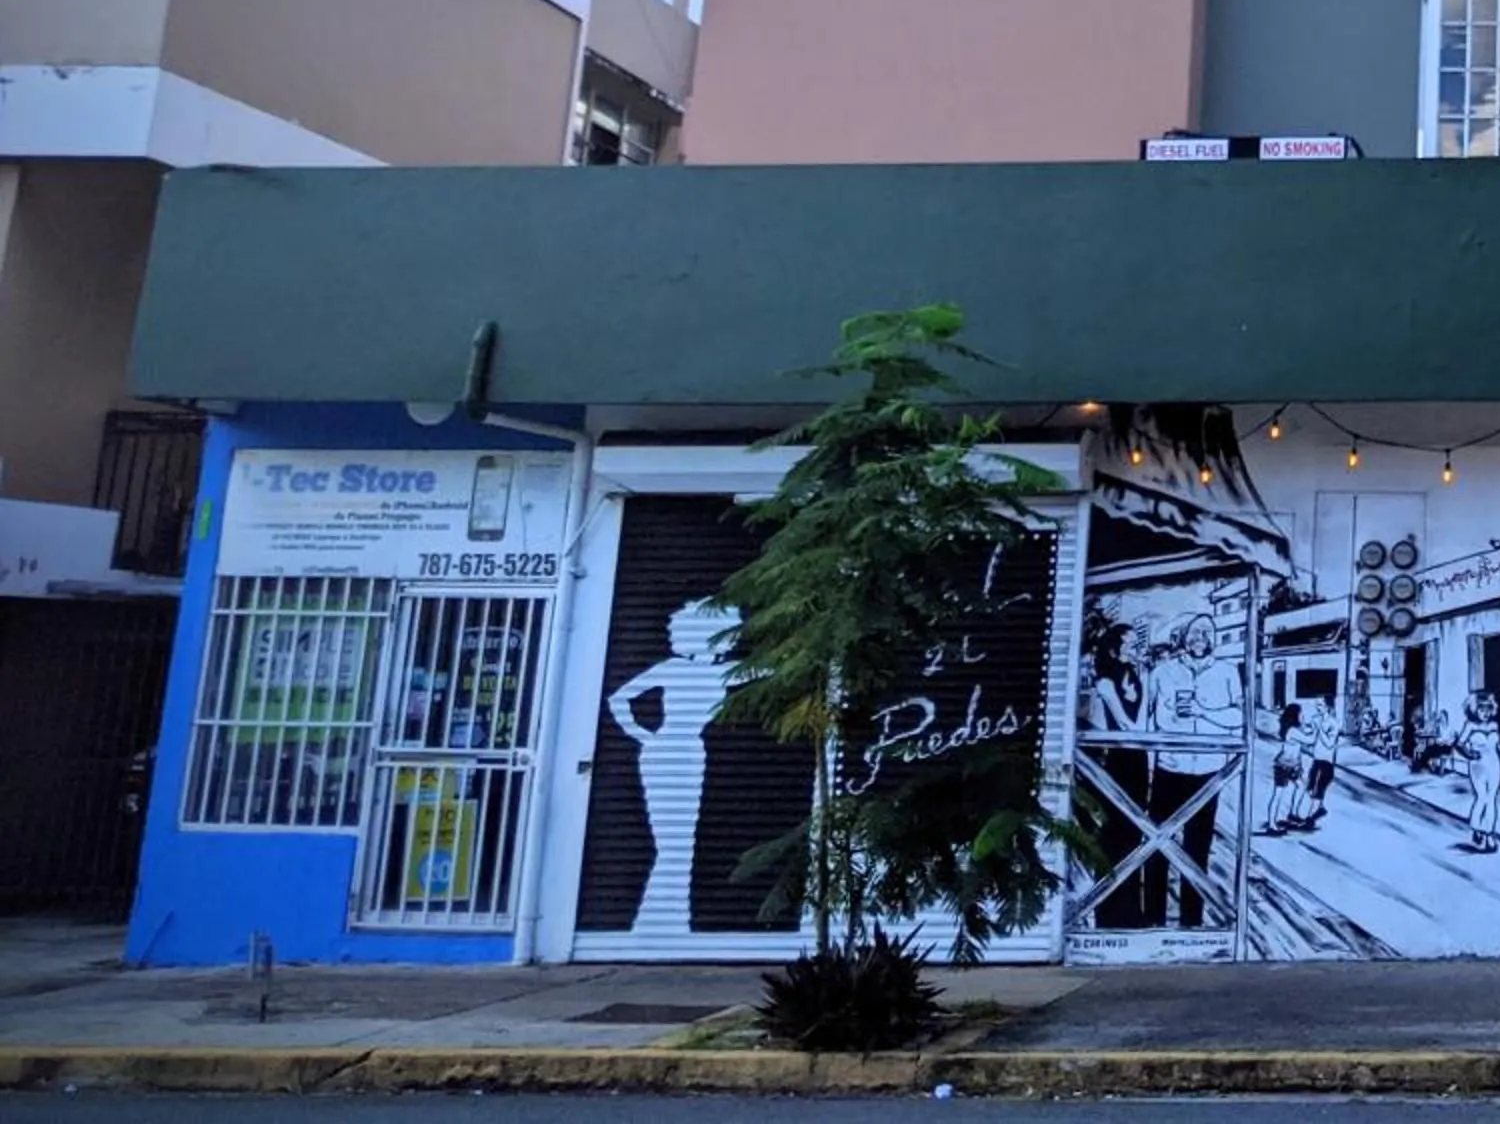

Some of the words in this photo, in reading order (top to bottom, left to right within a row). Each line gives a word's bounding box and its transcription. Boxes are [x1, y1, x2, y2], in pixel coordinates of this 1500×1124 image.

[1149, 144, 1191, 157] DIESEL
[1195, 144, 1226, 157] FUEL
[1263, 142, 1280, 156] NO
[1284, 142, 1342, 157] SMOKING
[338, 462, 437, 493] Store
[418, 553, 557, 577] 787-675-5225
